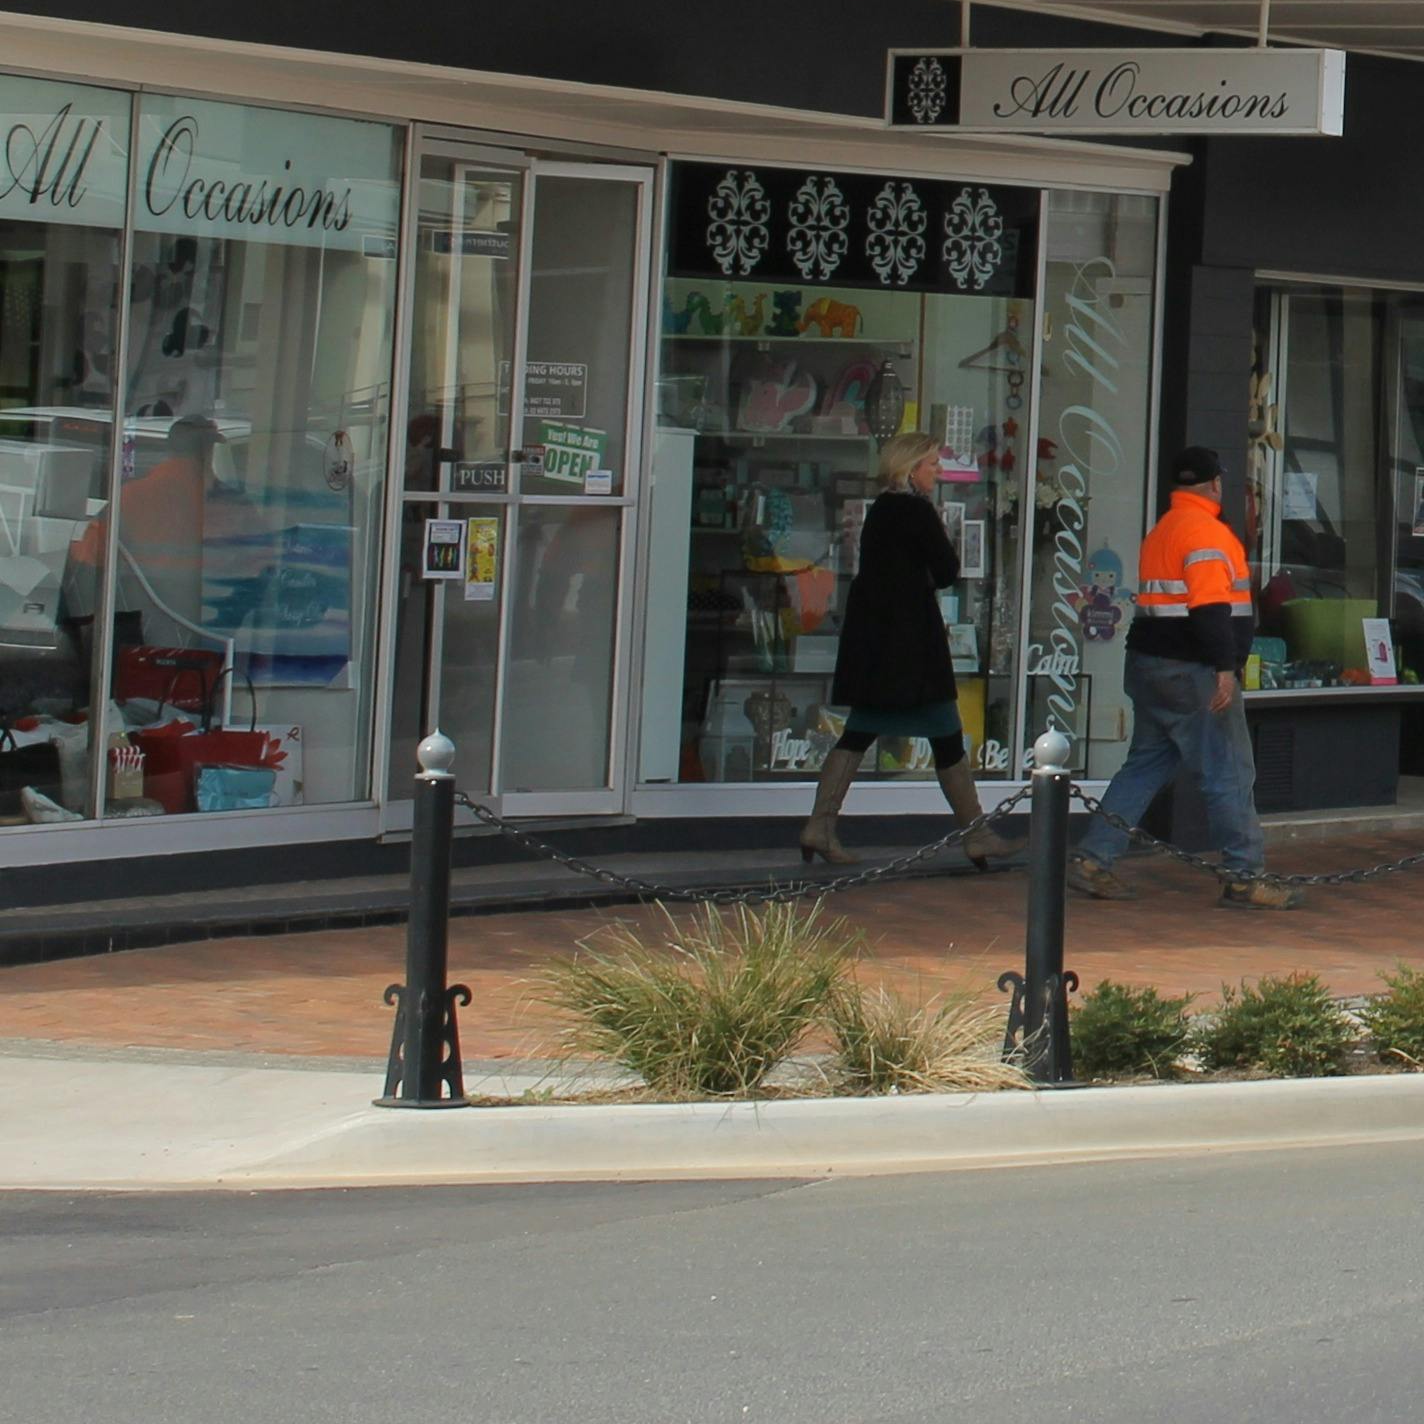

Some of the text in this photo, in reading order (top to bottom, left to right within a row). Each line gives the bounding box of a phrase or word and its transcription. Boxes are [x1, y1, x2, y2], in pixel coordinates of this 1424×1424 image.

[993, 61, 1291, 119] All Occasions
[0, 102, 354, 232] All Occasions
[1060, 255, 1128, 393] All
[549, 365, 584, 377] HOURS
[567, 432, 582, 444] We
[583, 435, 599, 449] Are
[460, 469, 505, 485] PUSH
[544, 448, 593, 479] OPEN
